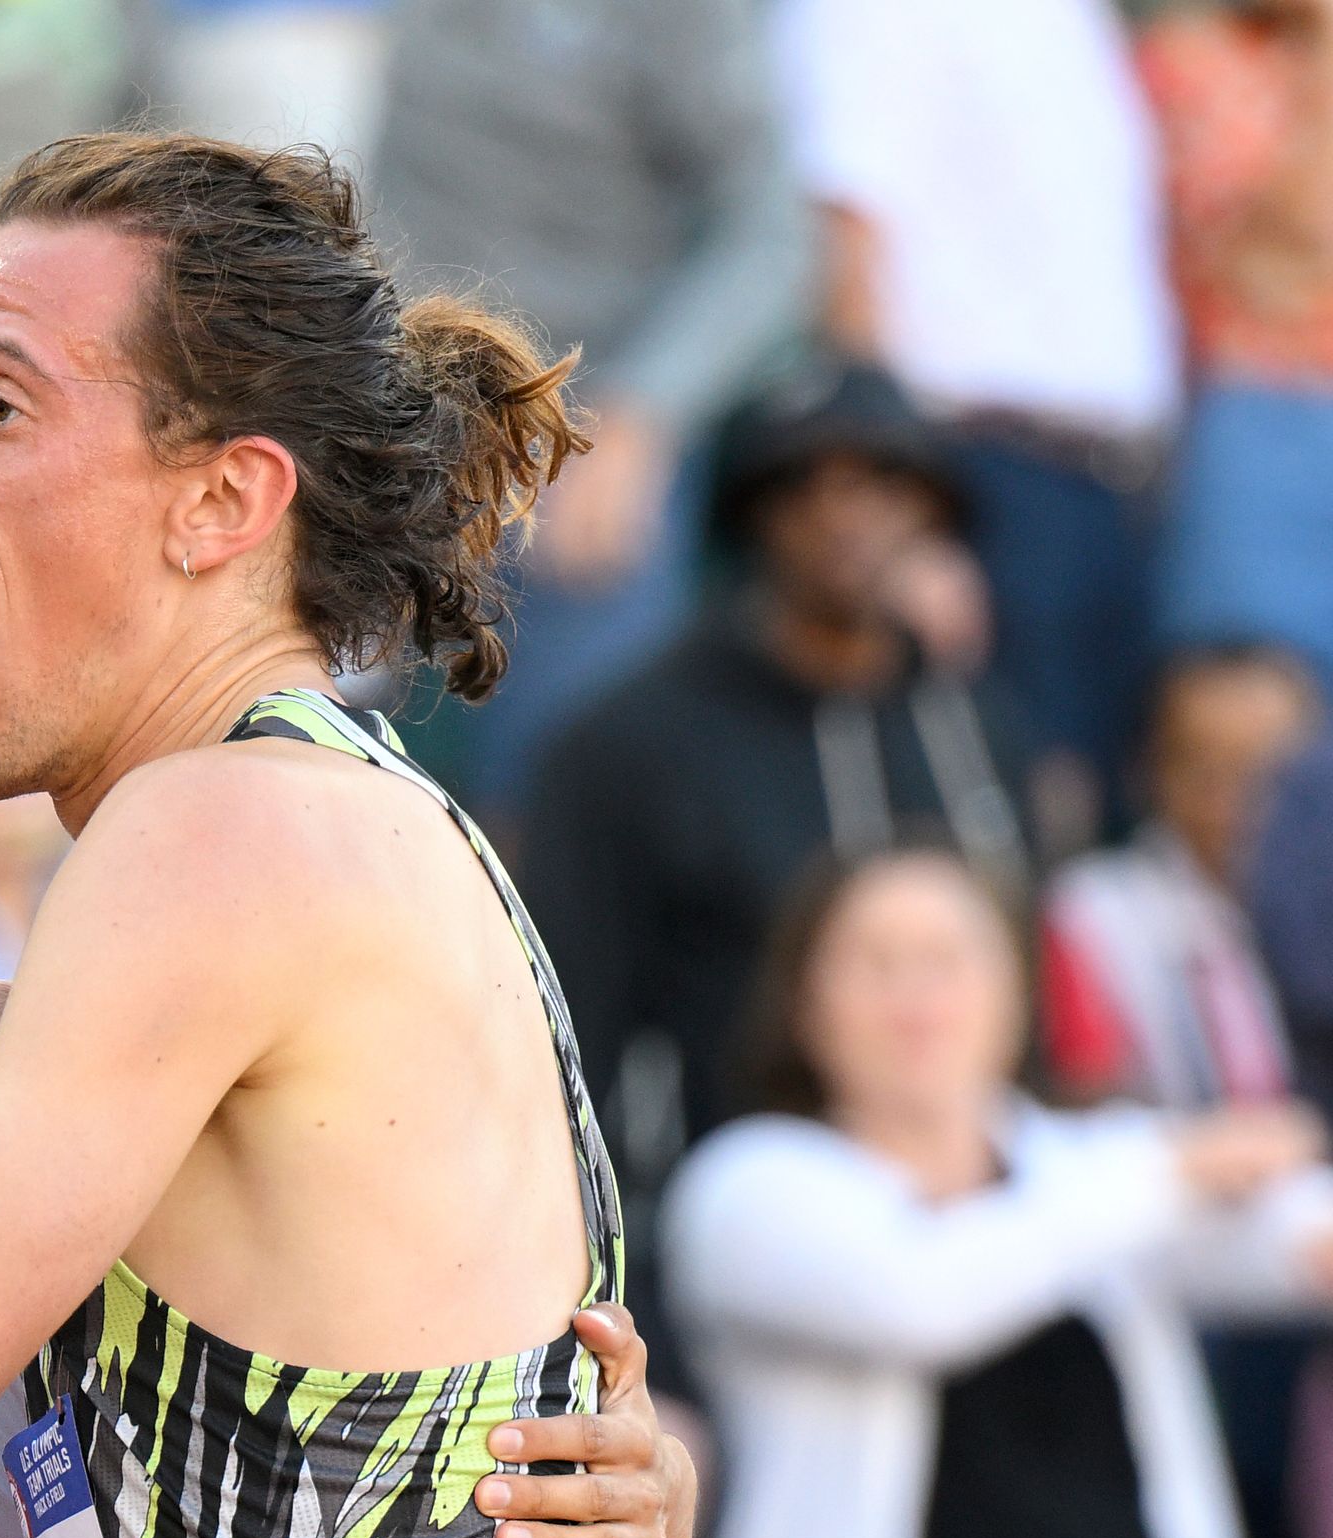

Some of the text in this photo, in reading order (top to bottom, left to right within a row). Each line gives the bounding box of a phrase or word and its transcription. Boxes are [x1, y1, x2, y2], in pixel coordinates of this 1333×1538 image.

[31, 1422, 64, 1461] OLYMPIC
[26, 1448, 71, 1500] TEAM TRIALS
[50, 1482, 65, 1506] FIELD
